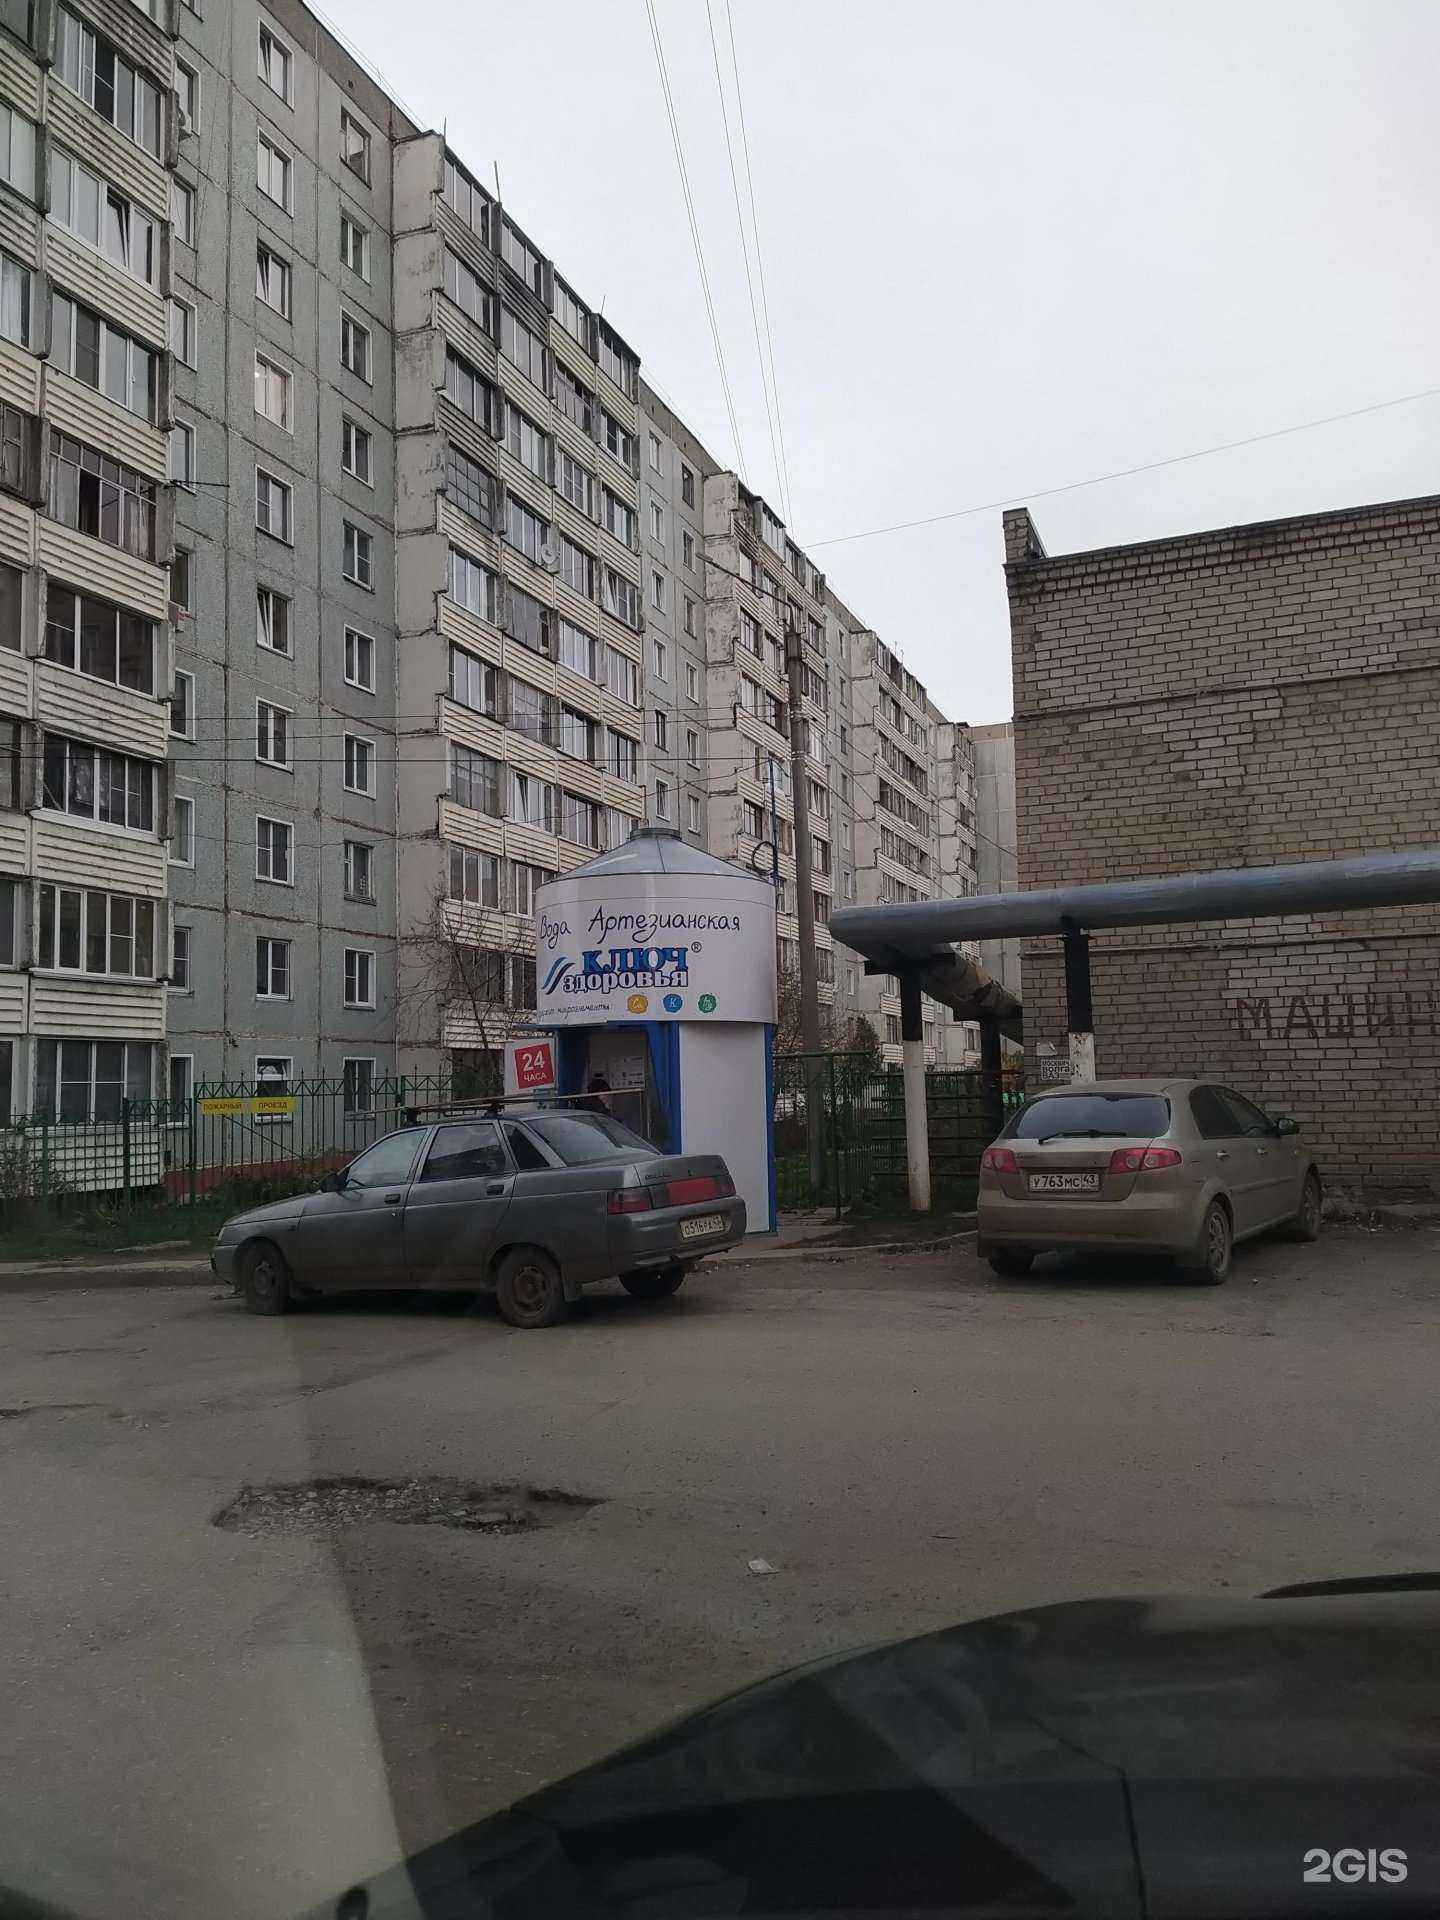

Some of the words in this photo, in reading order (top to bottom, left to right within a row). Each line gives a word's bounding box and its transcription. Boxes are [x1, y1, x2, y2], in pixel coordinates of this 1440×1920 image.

[539, 914, 572, 949] Вода
[587, 905, 741, 944] Артезианская
[582, 947, 689, 973] КЛЮЧ
[562, 970, 689, 995] здоровья
[522, 1050, 545, 1072] 24
[523, 1072, 547, 1082] ЧАСА
